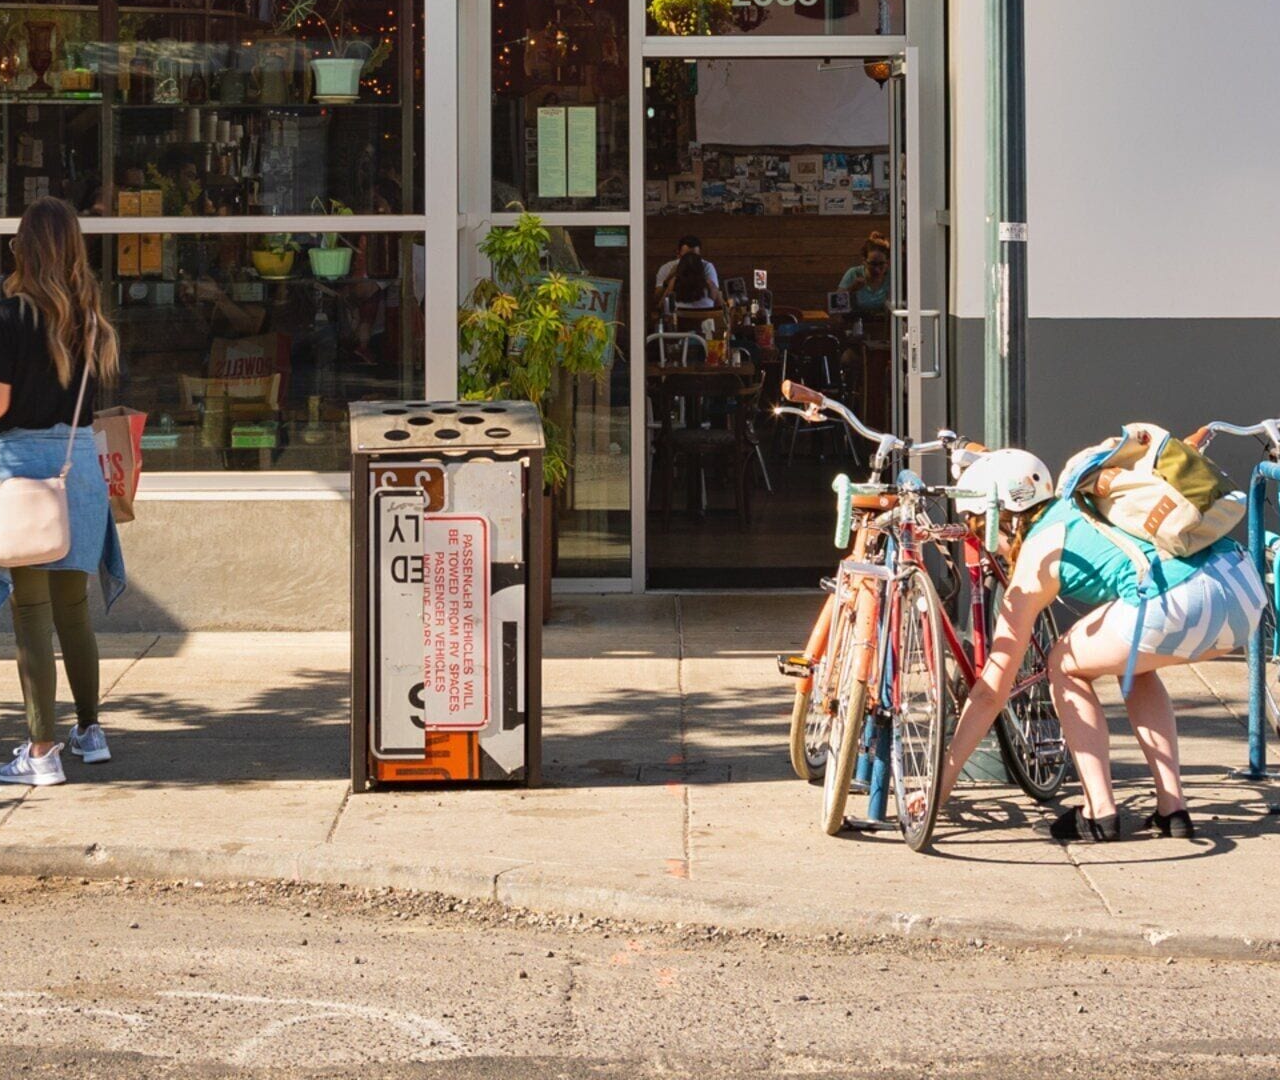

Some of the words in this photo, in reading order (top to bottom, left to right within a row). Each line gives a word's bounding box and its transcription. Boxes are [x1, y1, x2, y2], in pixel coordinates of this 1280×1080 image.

[448, 528, 459, 546] BE
[434, 551, 445, 627] PASSENGER
[448, 550, 460, 596] TOWED
[462, 533, 473, 610] PASSENGER
[448, 600, 460, 636] FROM
[435, 631, 446, 693] VEHICLES
[449, 641, 460, 658] RV
[463, 613, 474, 675] VEHICLES
[463, 680, 474, 710] WILL
